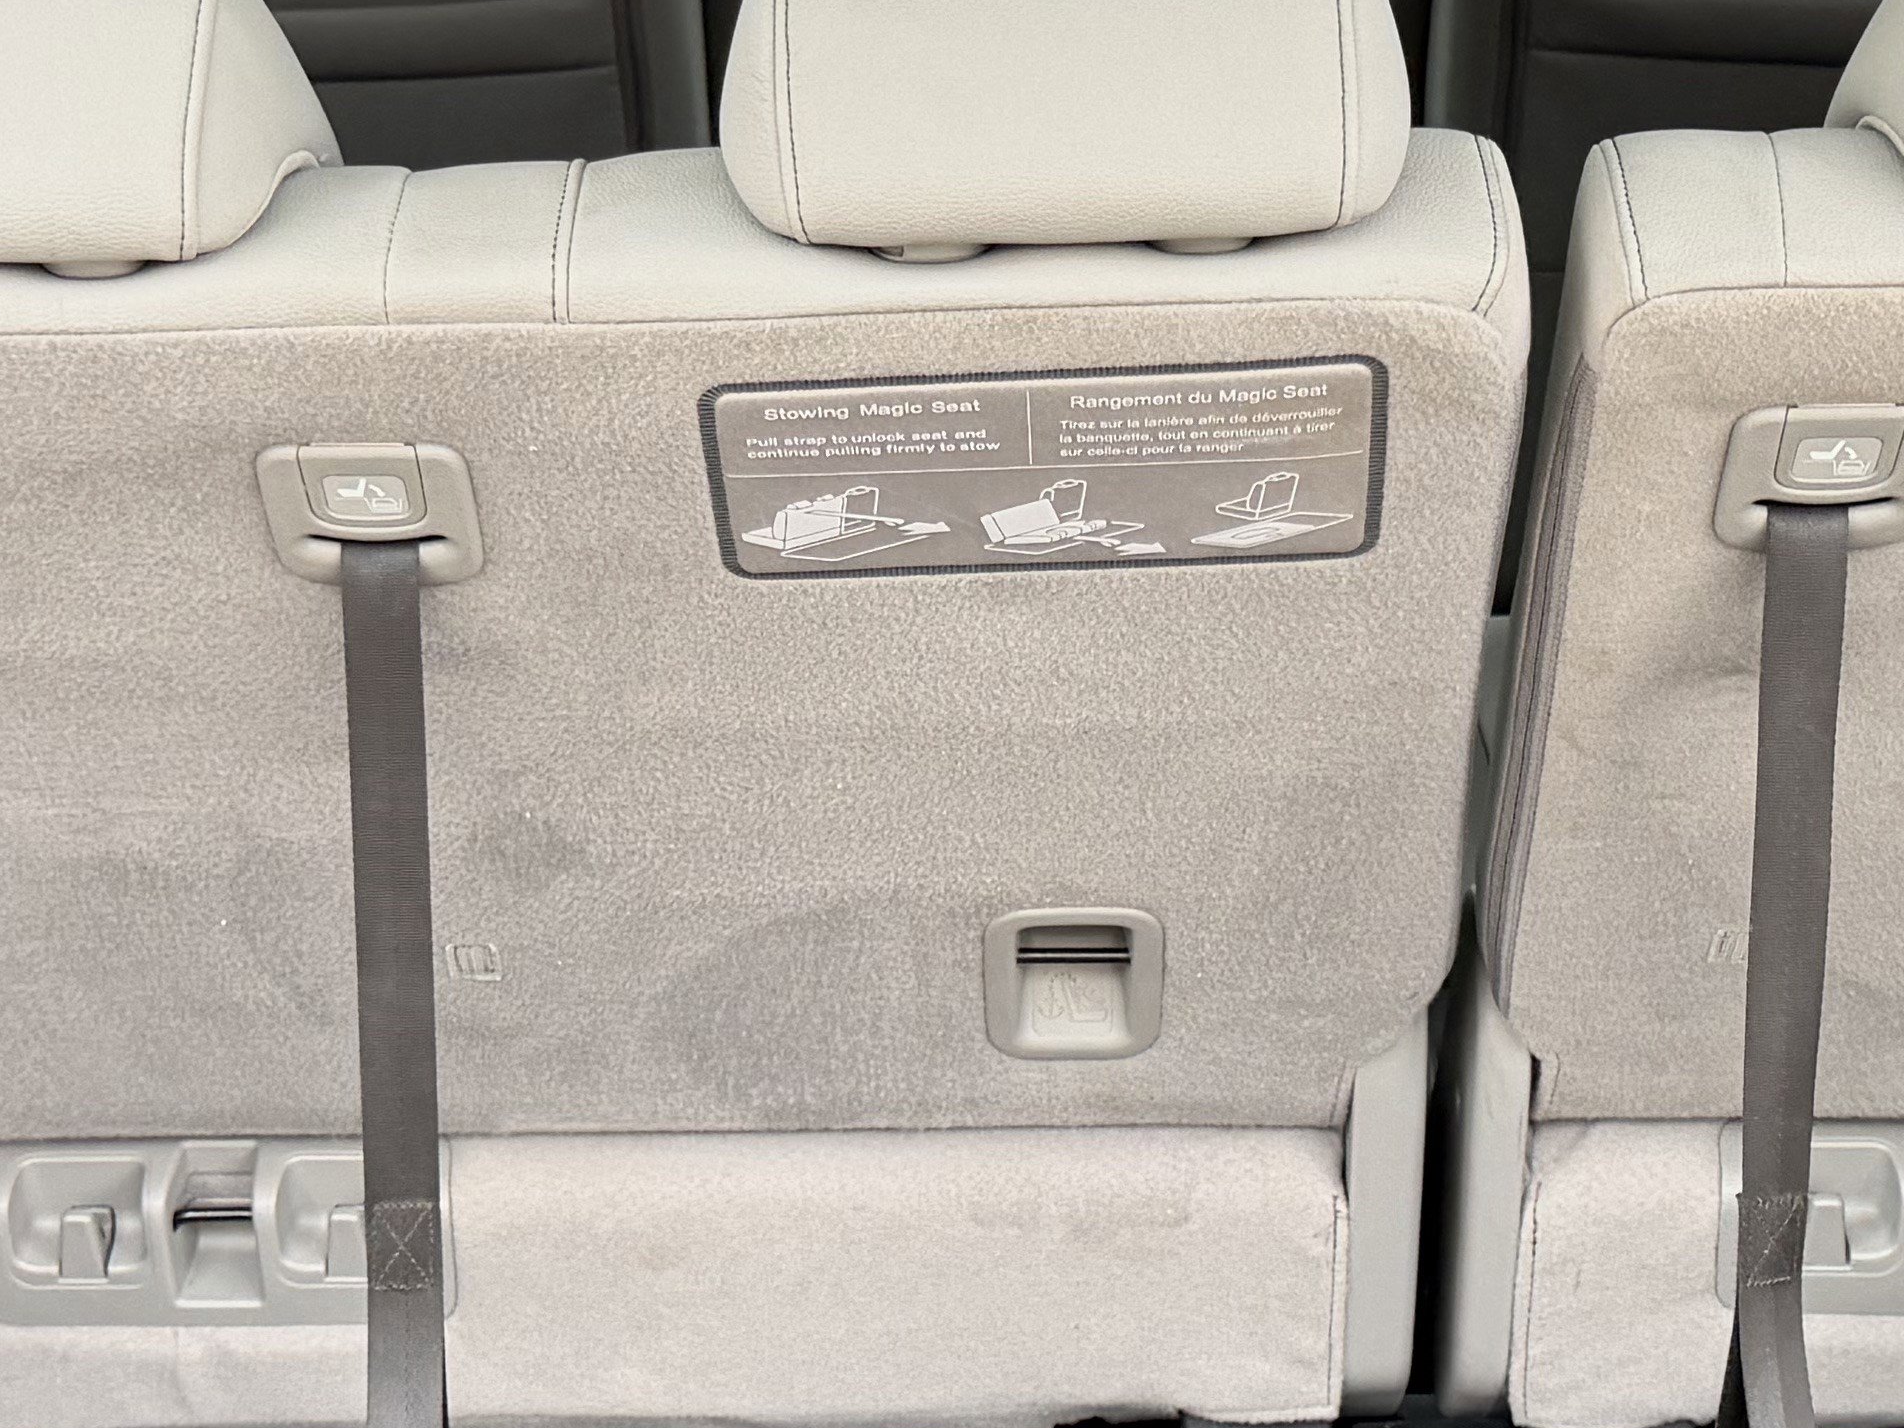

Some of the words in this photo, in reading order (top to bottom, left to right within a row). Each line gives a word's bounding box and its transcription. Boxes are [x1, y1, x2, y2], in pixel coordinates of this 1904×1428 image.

[1070, 393, 1183, 411] Rangement
[1188, 391, 1212, 404] du
[1219, 387, 1277, 404] Magic
[1283, 384, 1328, 399] Seat
[764, 405, 849, 420] Stowing
[860, 402, 923, 417] Magic
[931, 399, 981, 413] Seat
[1060, 419, 1095, 430] Tirez
[1100, 419, 1123, 429] sur
[1127, 418, 1140, 428] la
[1144, 415, 1194, 427] lanière
[1198, 414, 1225, 425] afin
[1230, 413, 1248, 424] de
[1252, 406, 1343, 423] déverrouiller
[746, 437, 778, 447] Pull
[783, 435, 827, 448] strap
[831, 434, 847, 445] to
[851, 432, 906, 444] unlock
[911, 430, 947, 441] seat
[954, 429, 987, 439] and
[1060, 433, 1072, 443] la
[1076, 430, 1154, 445] banquette,
[1158, 429, 1186, 440] tout
[1190, 430, 1209, 439] en
[1213, 425, 1288, 439] continuant
[1306, 421, 1335, 433] tirer
[747, 448, 820, 459] continue
[825, 445, 882, 458] pulling
[886, 442, 936, 455] firmly
[939, 441, 956, 452] to
[959, 440, 1001, 451] stow
[1060, 447, 1082, 457] sur
[1087, 445, 1137, 456] celle-ci
[1142, 445, 1174, 456] pour
[1178, 443, 1191, 453] la
[1196, 443, 1244, 454] ranger
